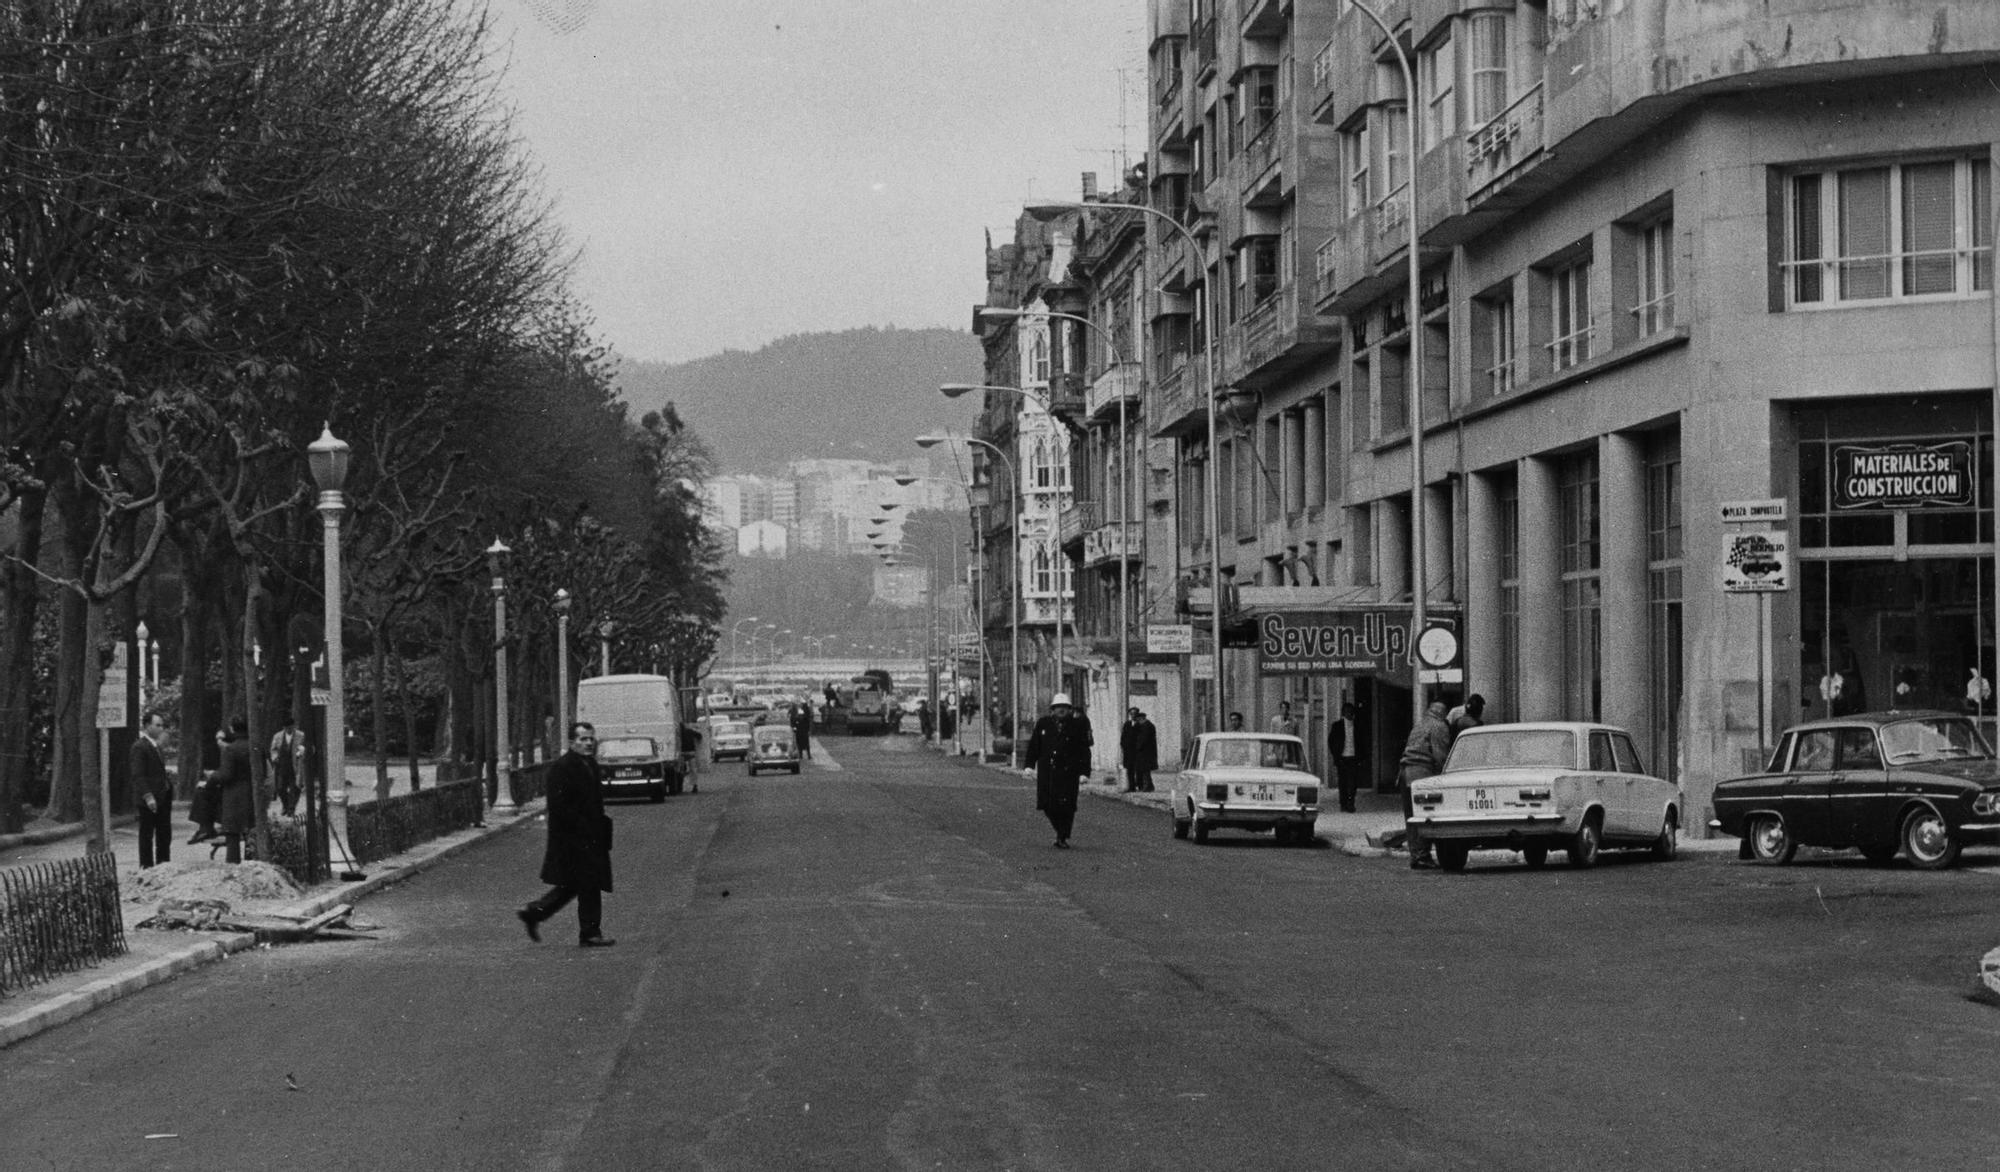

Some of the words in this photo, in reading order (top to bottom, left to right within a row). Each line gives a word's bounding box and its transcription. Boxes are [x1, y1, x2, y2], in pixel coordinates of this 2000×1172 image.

[1854, 453, 1936, 475] MATERIALES
[1937, 457, 1949, 471] DE
[1848, 474, 1957, 497] CONSTRUCCION
[1729, 507, 1746, 516] PLAZA
[1263, 613, 1404, 671] Seven-Up
